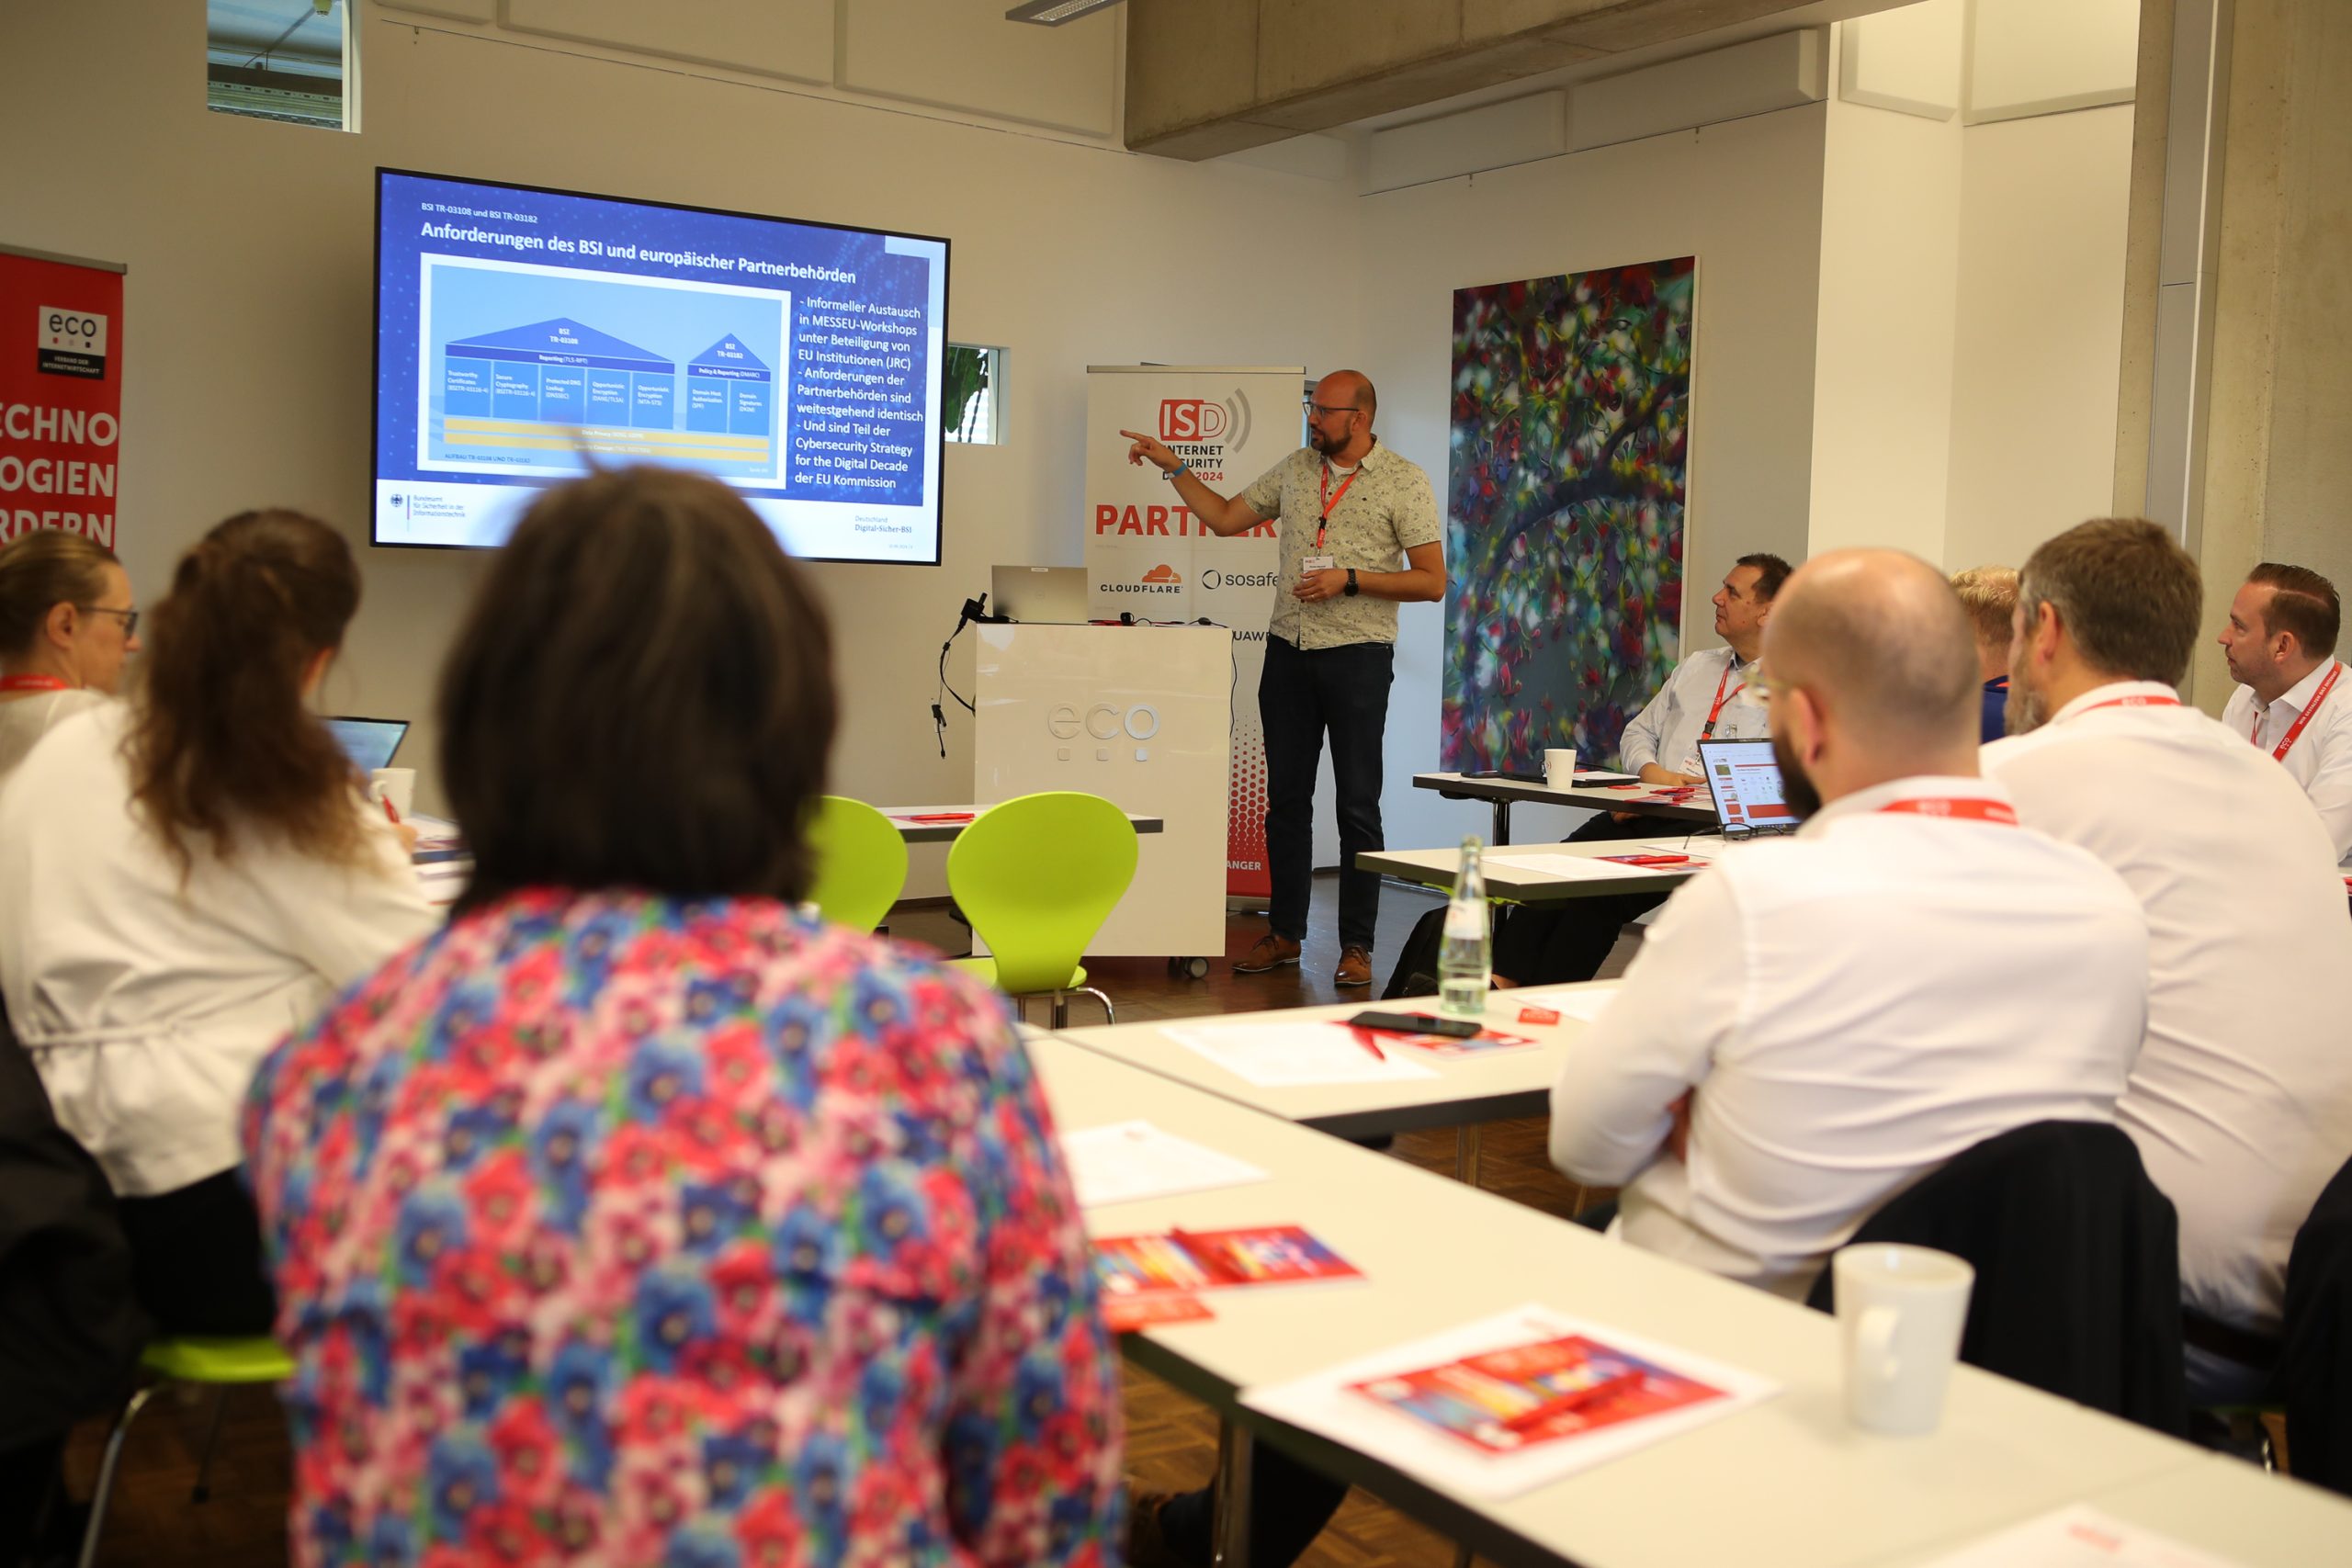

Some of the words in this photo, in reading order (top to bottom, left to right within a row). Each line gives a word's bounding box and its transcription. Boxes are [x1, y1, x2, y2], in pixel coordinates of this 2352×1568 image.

[421, 202, 434, 212] BSI
[435, 204, 472, 216] TR-03108
[473, 209, 488, 218] und
[489, 210, 502, 220] BSI
[503, 212, 538, 223] TR-03182
[421, 221, 544, 250] Anforderungen
[548, 236, 575, 254] des
[579, 240, 603, 255] BSI
[606, 244, 636, 260] und
[639, 248, 735, 270] europäischer
[738, 257, 856, 284] Partnerbehörden
[807, 296, 866, 313] Informeller
[868, 302, 921, 319] Austausch
[49, 314, 96, 337] eco
[799, 313, 809, 325] in
[812, 314, 918, 337] MESSEU-Workshops
[798, 333, 828, 344] unter
[831, 334, 889, 352] Beteiligung
[891, 341, 910, 353] von
[798, 349, 814, 361] EU
[816, 351, 884, 367] Institutionen
[886, 355, 911, 372] (JRC)
[804, 367, 884, 385] Anforderungen
[887, 374, 905, 387] der
[797, 384, 888, 402] Partnerbehörden
[889, 392, 911, 404] sind
[797, 402, 875, 419] weitestgehend
[877, 407, 923, 423] identisch
[1163, 402, 1227, 438] ISD
[0, 402, 119, 446] CHNO
[803, 420, 826, 432] Und
[828, 422, 850, 434] sind
[852, 423, 871, 435] Teil
[873, 424, 891, 436] der
[795, 436, 868, 455] Cybersecurity
[870, 442, 913, 457] Strategy
[1164, 445, 1224, 456] NTERNET
[795, 454, 811, 466] for
[813, 456, 831, 468] the
[834, 457, 868, 471] Digital
[870, 457, 909, 472] Decade
[1181, 458, 1224, 468] URITY
[795, 471, 813, 484] der
[816, 473, 831, 485] EU
[833, 474, 897, 489] Kommission
[1195, 471, 1224, 481] 2024
[854, 524, 912, 534] Digital-Sicher-BSI
[1095, 504, 1277, 537] PARTR
[1100, 583, 1181, 594] CLOUDFLARE
[1047, 702, 1160, 740] eco
[1227, 860, 1261, 871] ANGER
